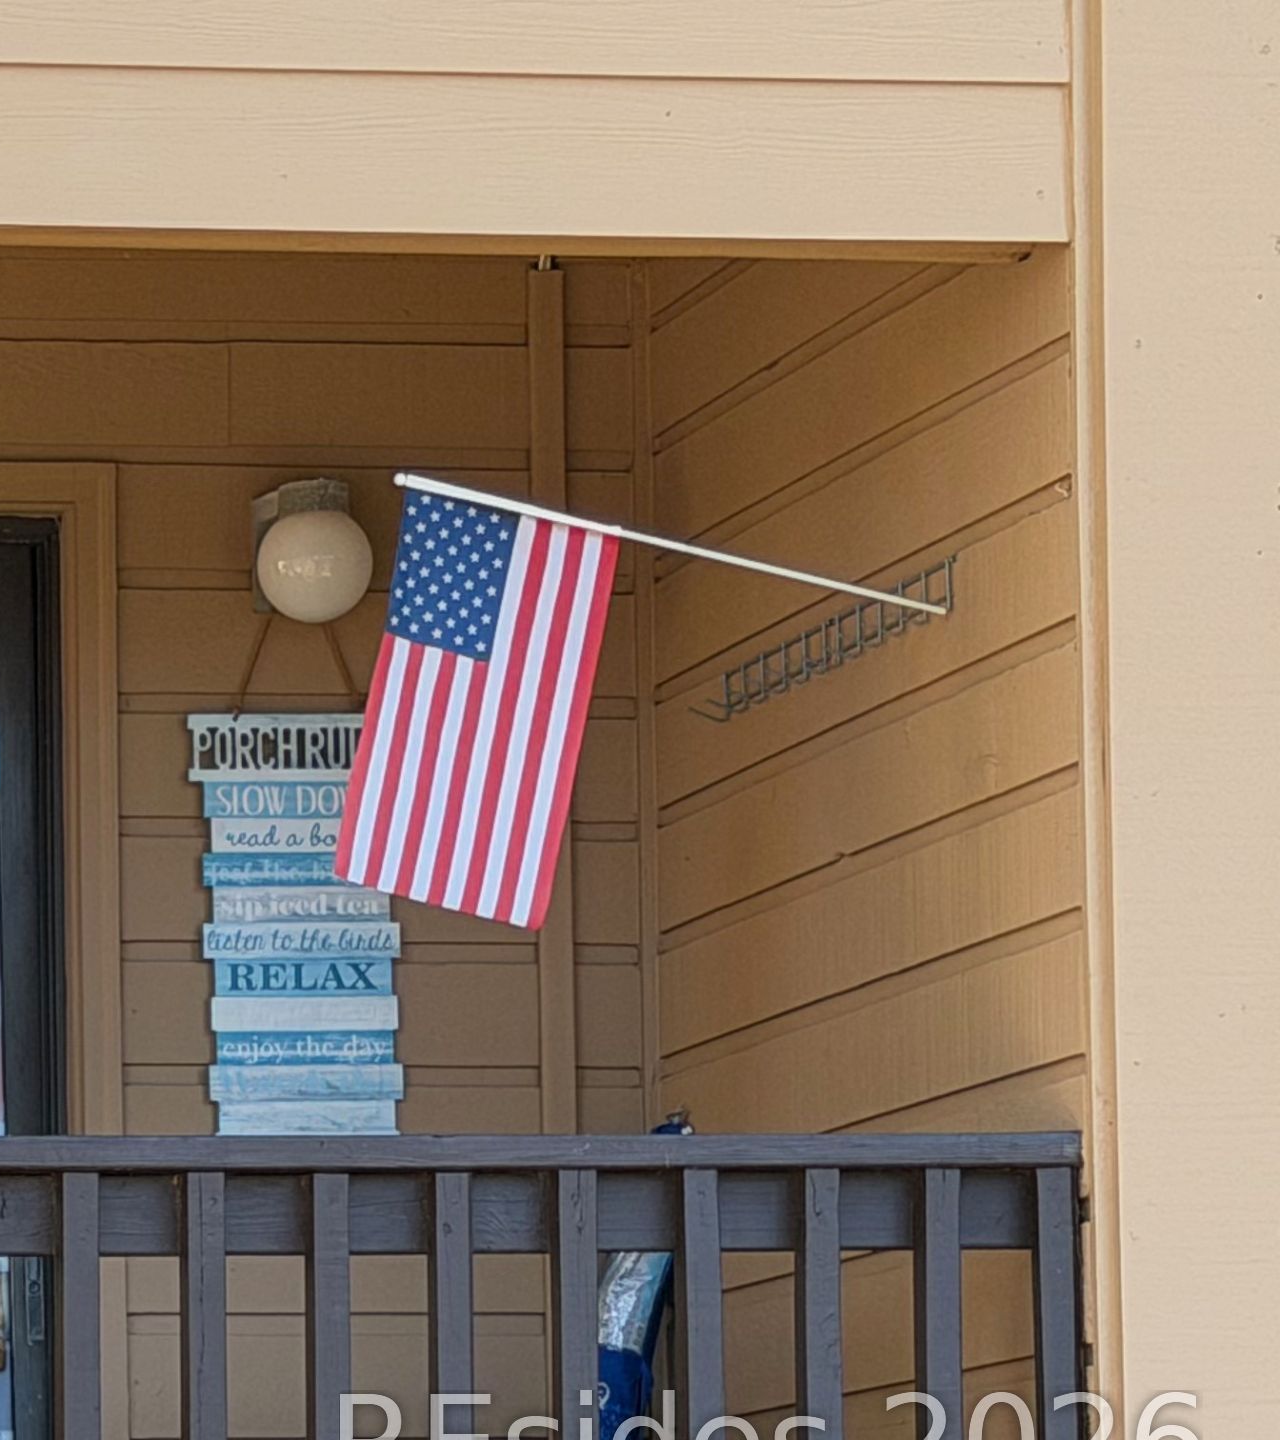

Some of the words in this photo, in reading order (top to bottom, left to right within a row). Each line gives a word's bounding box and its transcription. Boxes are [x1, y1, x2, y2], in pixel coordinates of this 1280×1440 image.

[193, 726, 297, 770] PORCH
[216, 785, 287, 817] SLOW
[225, 824, 281, 848] read
[286, 833, 304, 848] a
[218, 894, 263, 921] sip
[269, 893, 328, 916] iced
[336, 896, 380, 916] tea
[207, 929, 265, 951] listen
[272, 929, 293, 951] to
[300, 929, 333, 951] the
[338, 929, 395, 951] birds
[228, 962, 379, 991] RELAX
[223, 1036, 289, 1064] enjoy
[296, 1035, 335, 1057] the
[343, 1034, 387, 1063] day
